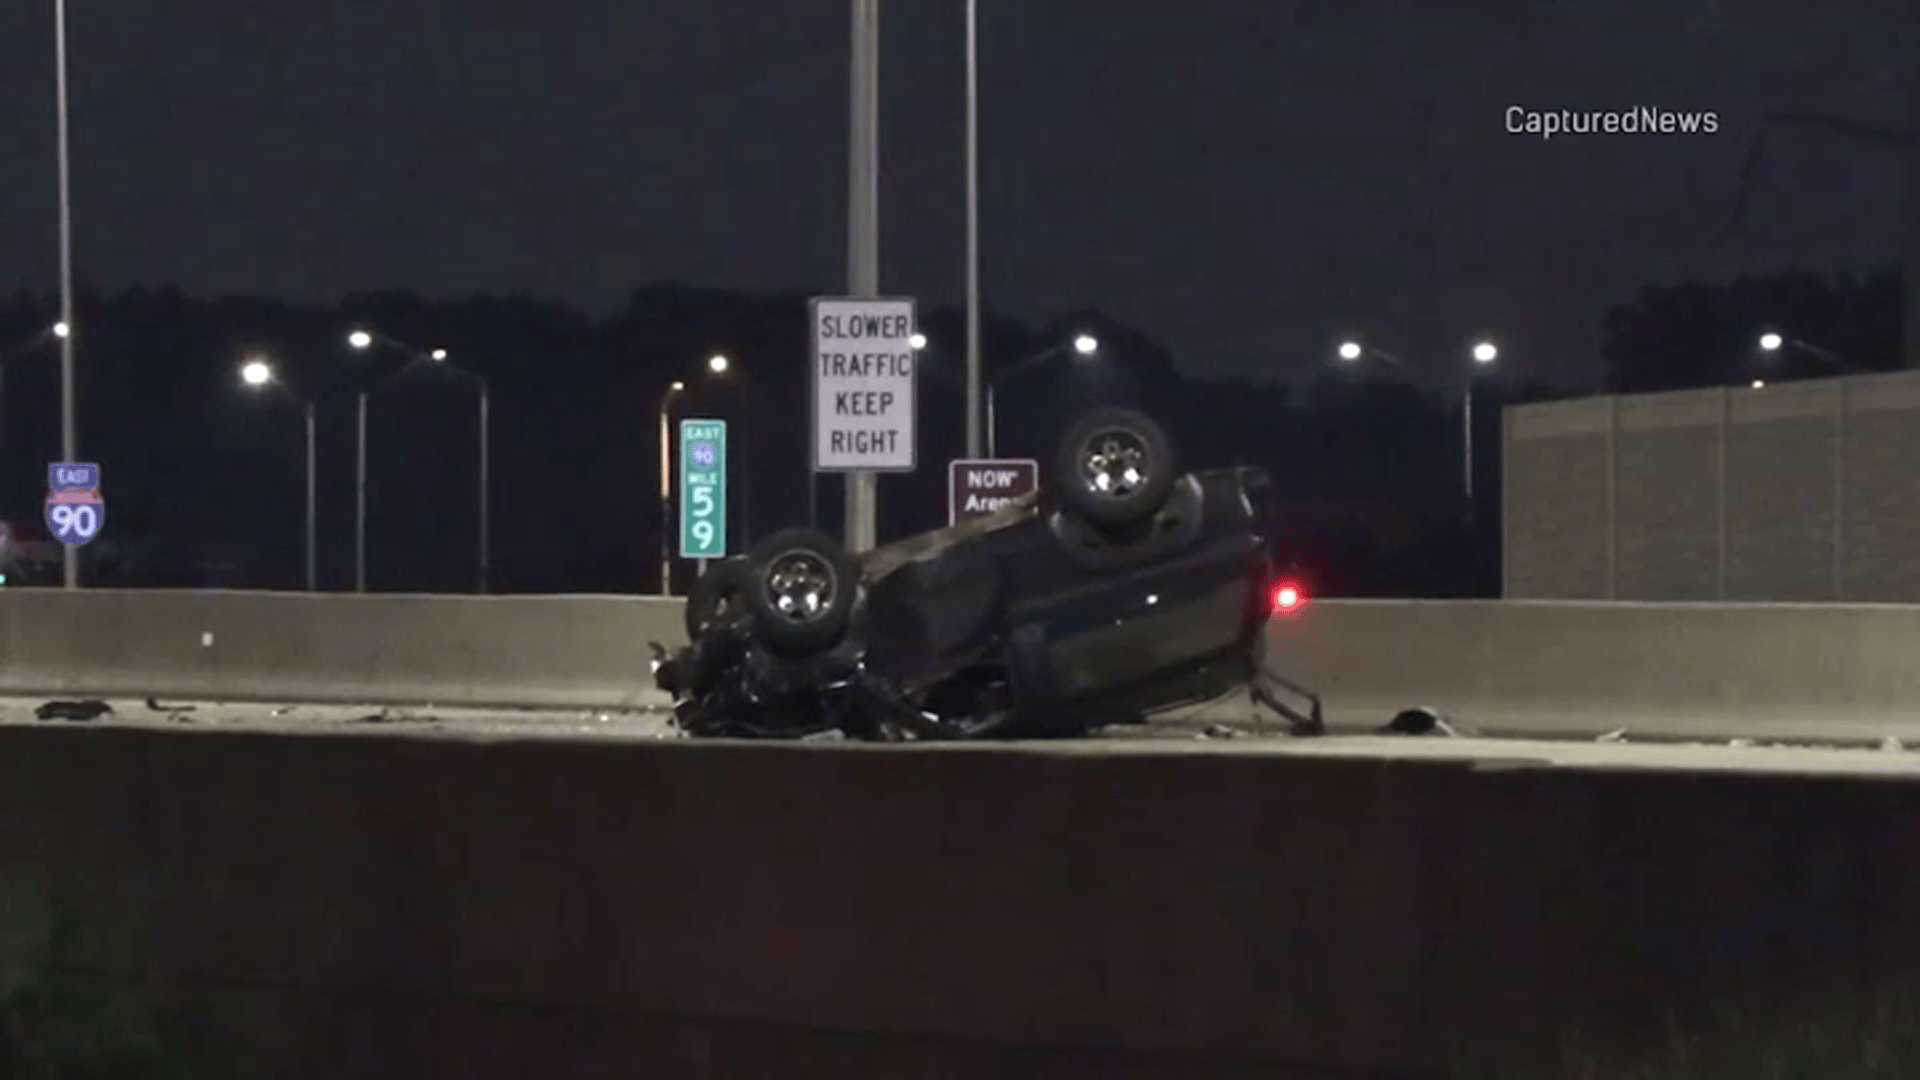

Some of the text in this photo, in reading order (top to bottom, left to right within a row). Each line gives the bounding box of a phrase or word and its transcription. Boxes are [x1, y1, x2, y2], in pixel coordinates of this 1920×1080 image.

[821, 315, 908, 339] SLOWER
[821, 353, 910, 377] TRAFFIC
[836, 391, 894, 415] KEEP
[831, 429, 898, 454] RIGHT
[51, 505, 97, 537] 90
